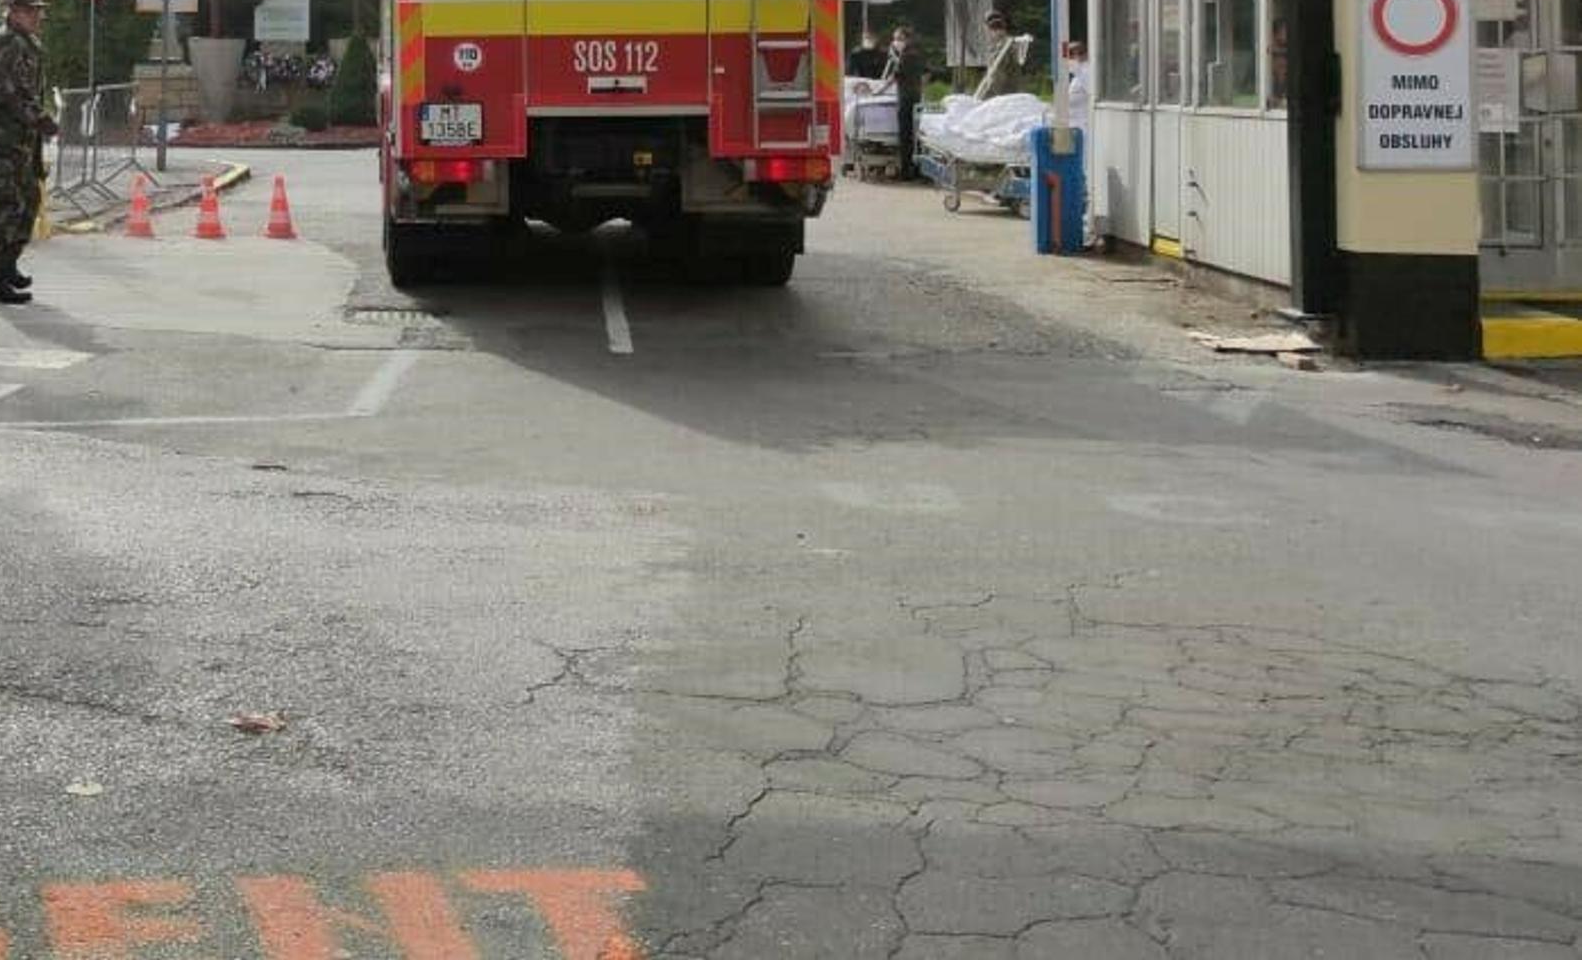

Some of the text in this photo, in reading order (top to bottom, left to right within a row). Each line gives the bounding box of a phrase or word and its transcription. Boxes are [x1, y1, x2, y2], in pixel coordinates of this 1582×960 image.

[574, 40, 659, 72] SOS 112
[1392, 74, 1439, 90] MIMO
[1368, 103, 1463, 120] DOPRAVNEJ
[1379, 133, 1452, 149] OBSLUHY
